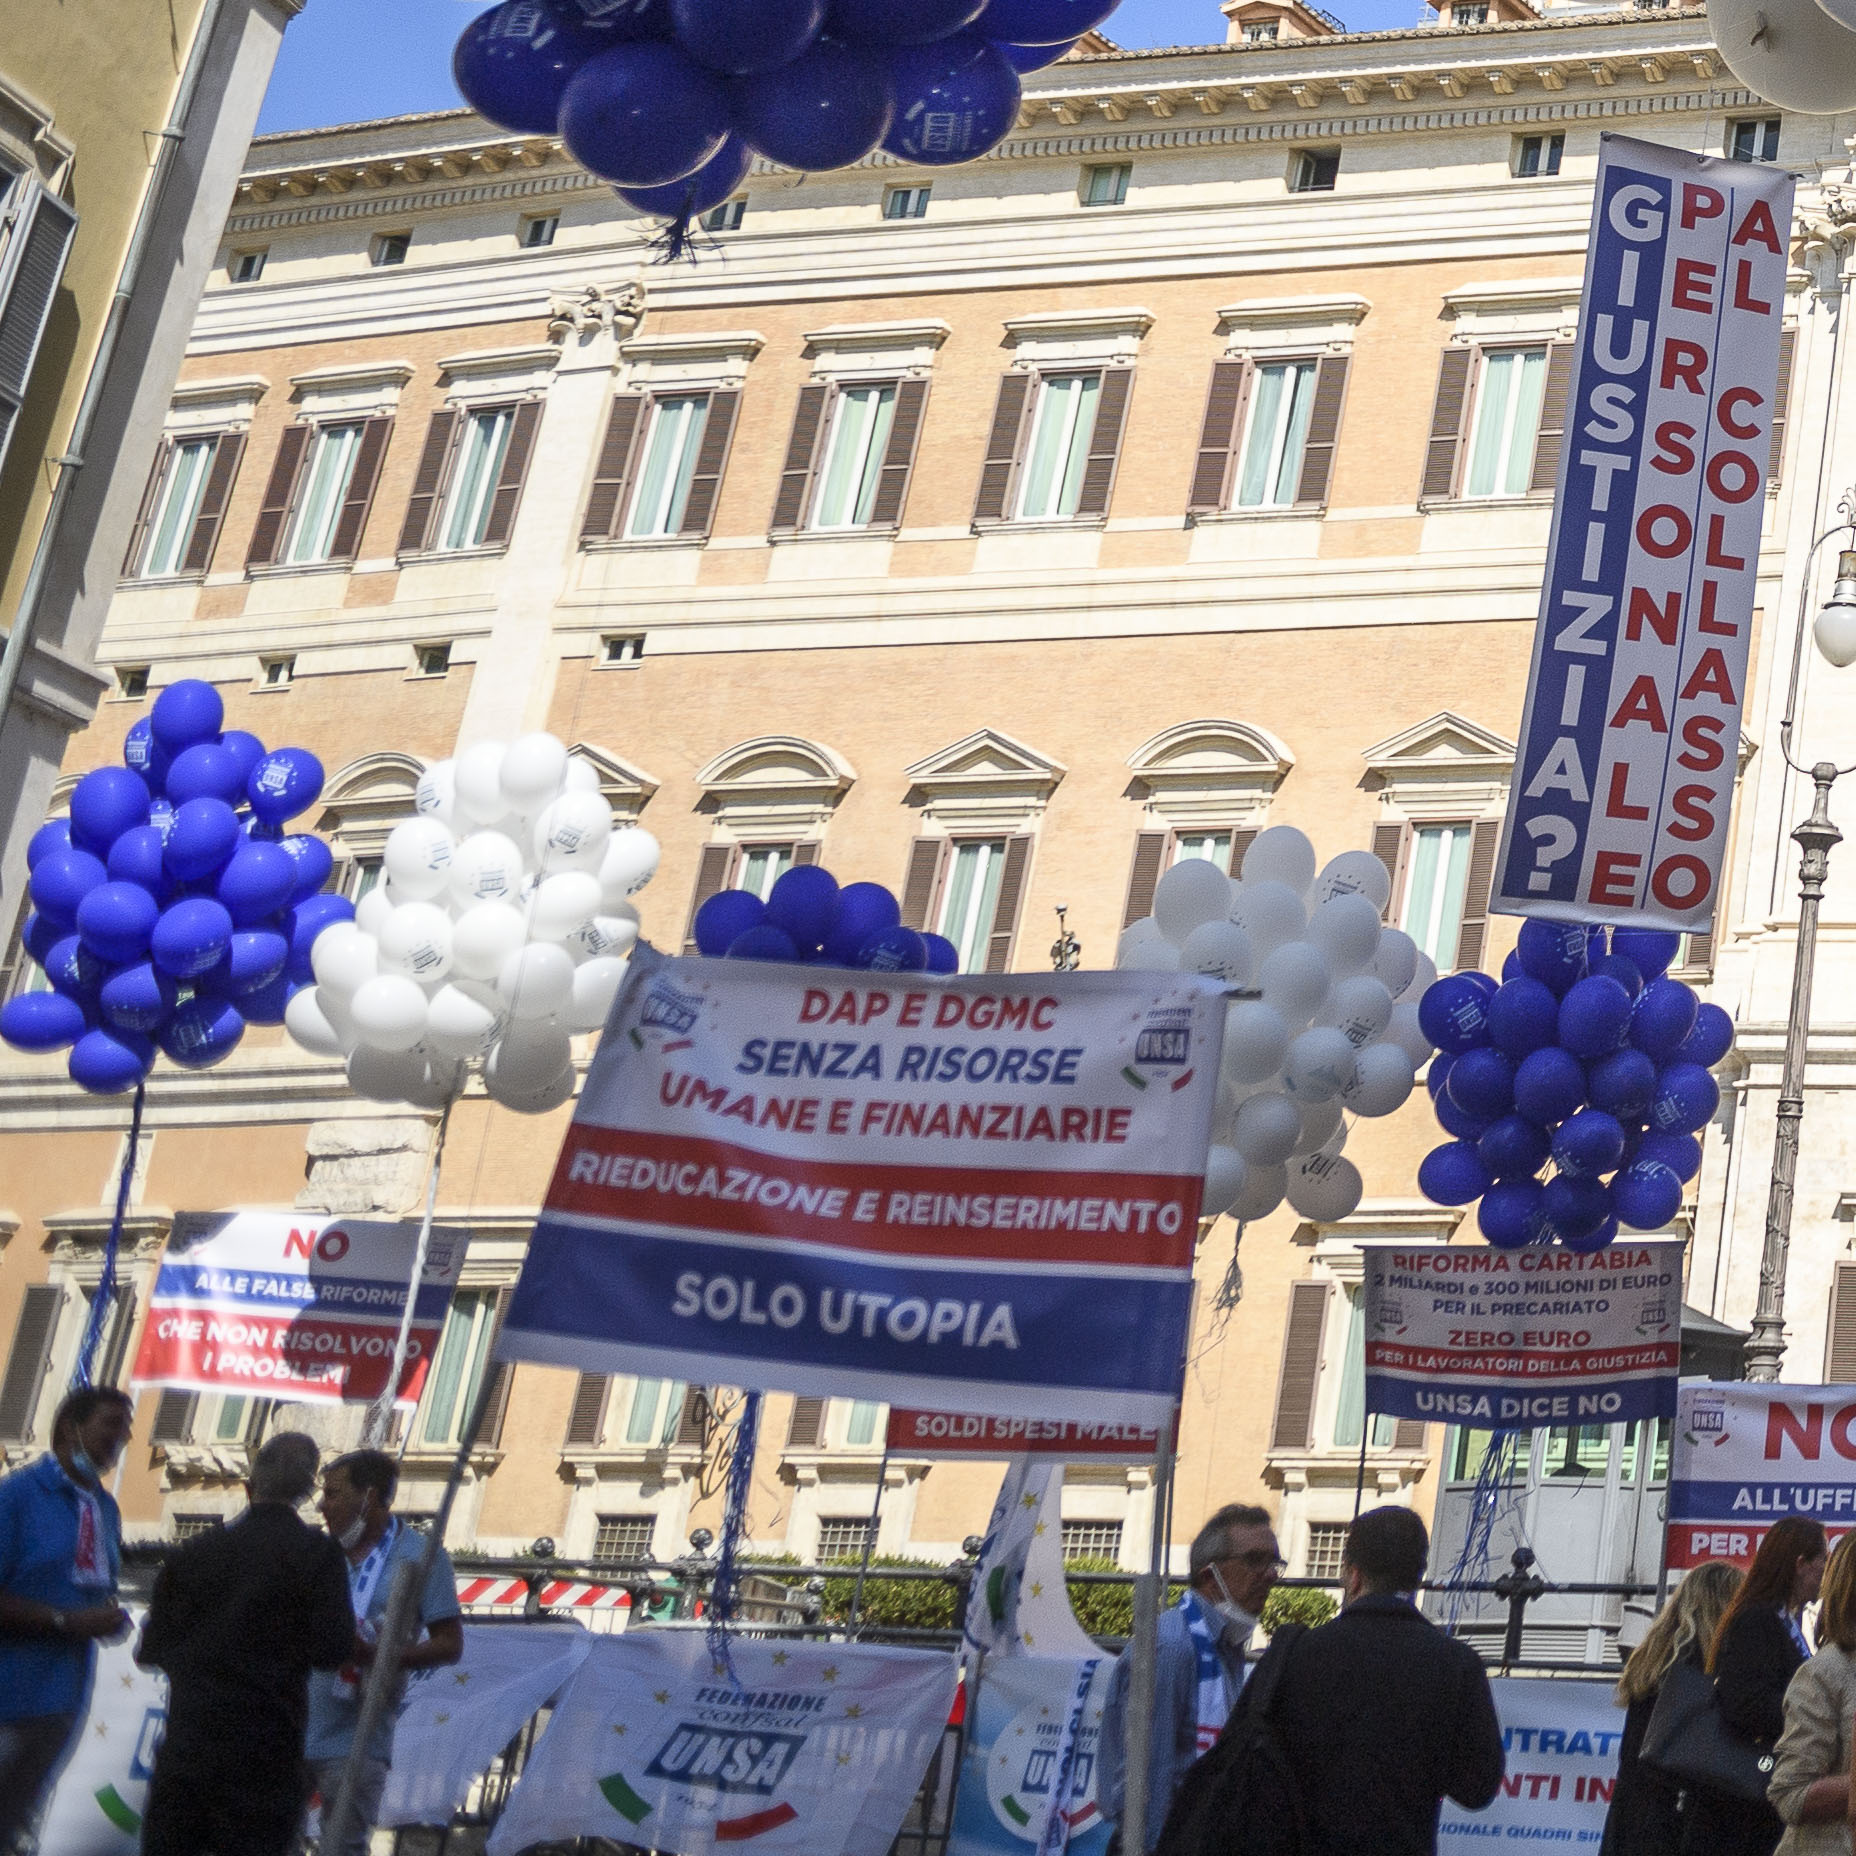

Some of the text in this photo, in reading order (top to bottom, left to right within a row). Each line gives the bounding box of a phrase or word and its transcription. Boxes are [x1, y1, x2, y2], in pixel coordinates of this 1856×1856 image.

[1731, 198, 1784, 316] AL
[1590, 181, 1727, 909] PERSONALE
[1650, 385, 1766, 911] COLLASSO
[798, 989, 1059, 1033] DAP E DGMC
[1136, 1032, 1185, 1060] UNSA
[735, 1037, 1086, 1086] SENZA RISORSE
[658, 1071, 1134, 1145] UMANE E FINANZIARIE
[566, 1149, 1184, 1237] RIEDUCAZIONE E REINSERIMENTO
[282, 1228, 351, 1262] NO
[1392, 1248, 1653, 1273] RIFORMA CARTABIA
[195, 1272, 410, 1306] ALLE FALSE RIFORME
[1388, 1275, 1465, 1295] MILIARDI
[1483, 1280, 1520, 1296] 300
[1523, 1276, 1595, 1295] MILIONI
[1598, 1276, 1619, 1292] DI
[1622, 1272, 1673, 1291] EURO
[671, 1270, 1021, 1350] SOLO UTOPIA
[1431, 1298, 1611, 1317] PER IL PRECARIATO
[157, 1318, 205, 1340] CHE
[206, 1322, 269, 1347] NON
[1448, 1329, 1592, 1348] ZERO EURO
[202, 1351, 351, 1384] I PROBLEMI
[1374, 1350, 1405, 1365] PER
[1416, 1352, 1524, 1373] LAVORATORI
[1527, 1357, 1582, 1374] DELLA
[1585, 1350, 1669, 1371] GIUSTIZIA
[1414, 1391, 1622, 1420] UNSA DICE NO
[913, 1414, 987, 1439] SOLDI
[992, 1417, 1068, 1441] SPESI
[1693, 1411, 1723, 1431] UNSA
[1690, 1532, 1749, 1557] PER
[695, 1687, 828, 1713] FEDERAZIONE
[660, 1730, 792, 1787] UNSA
[1506, 1824, 1572, 1842] QUADRI
